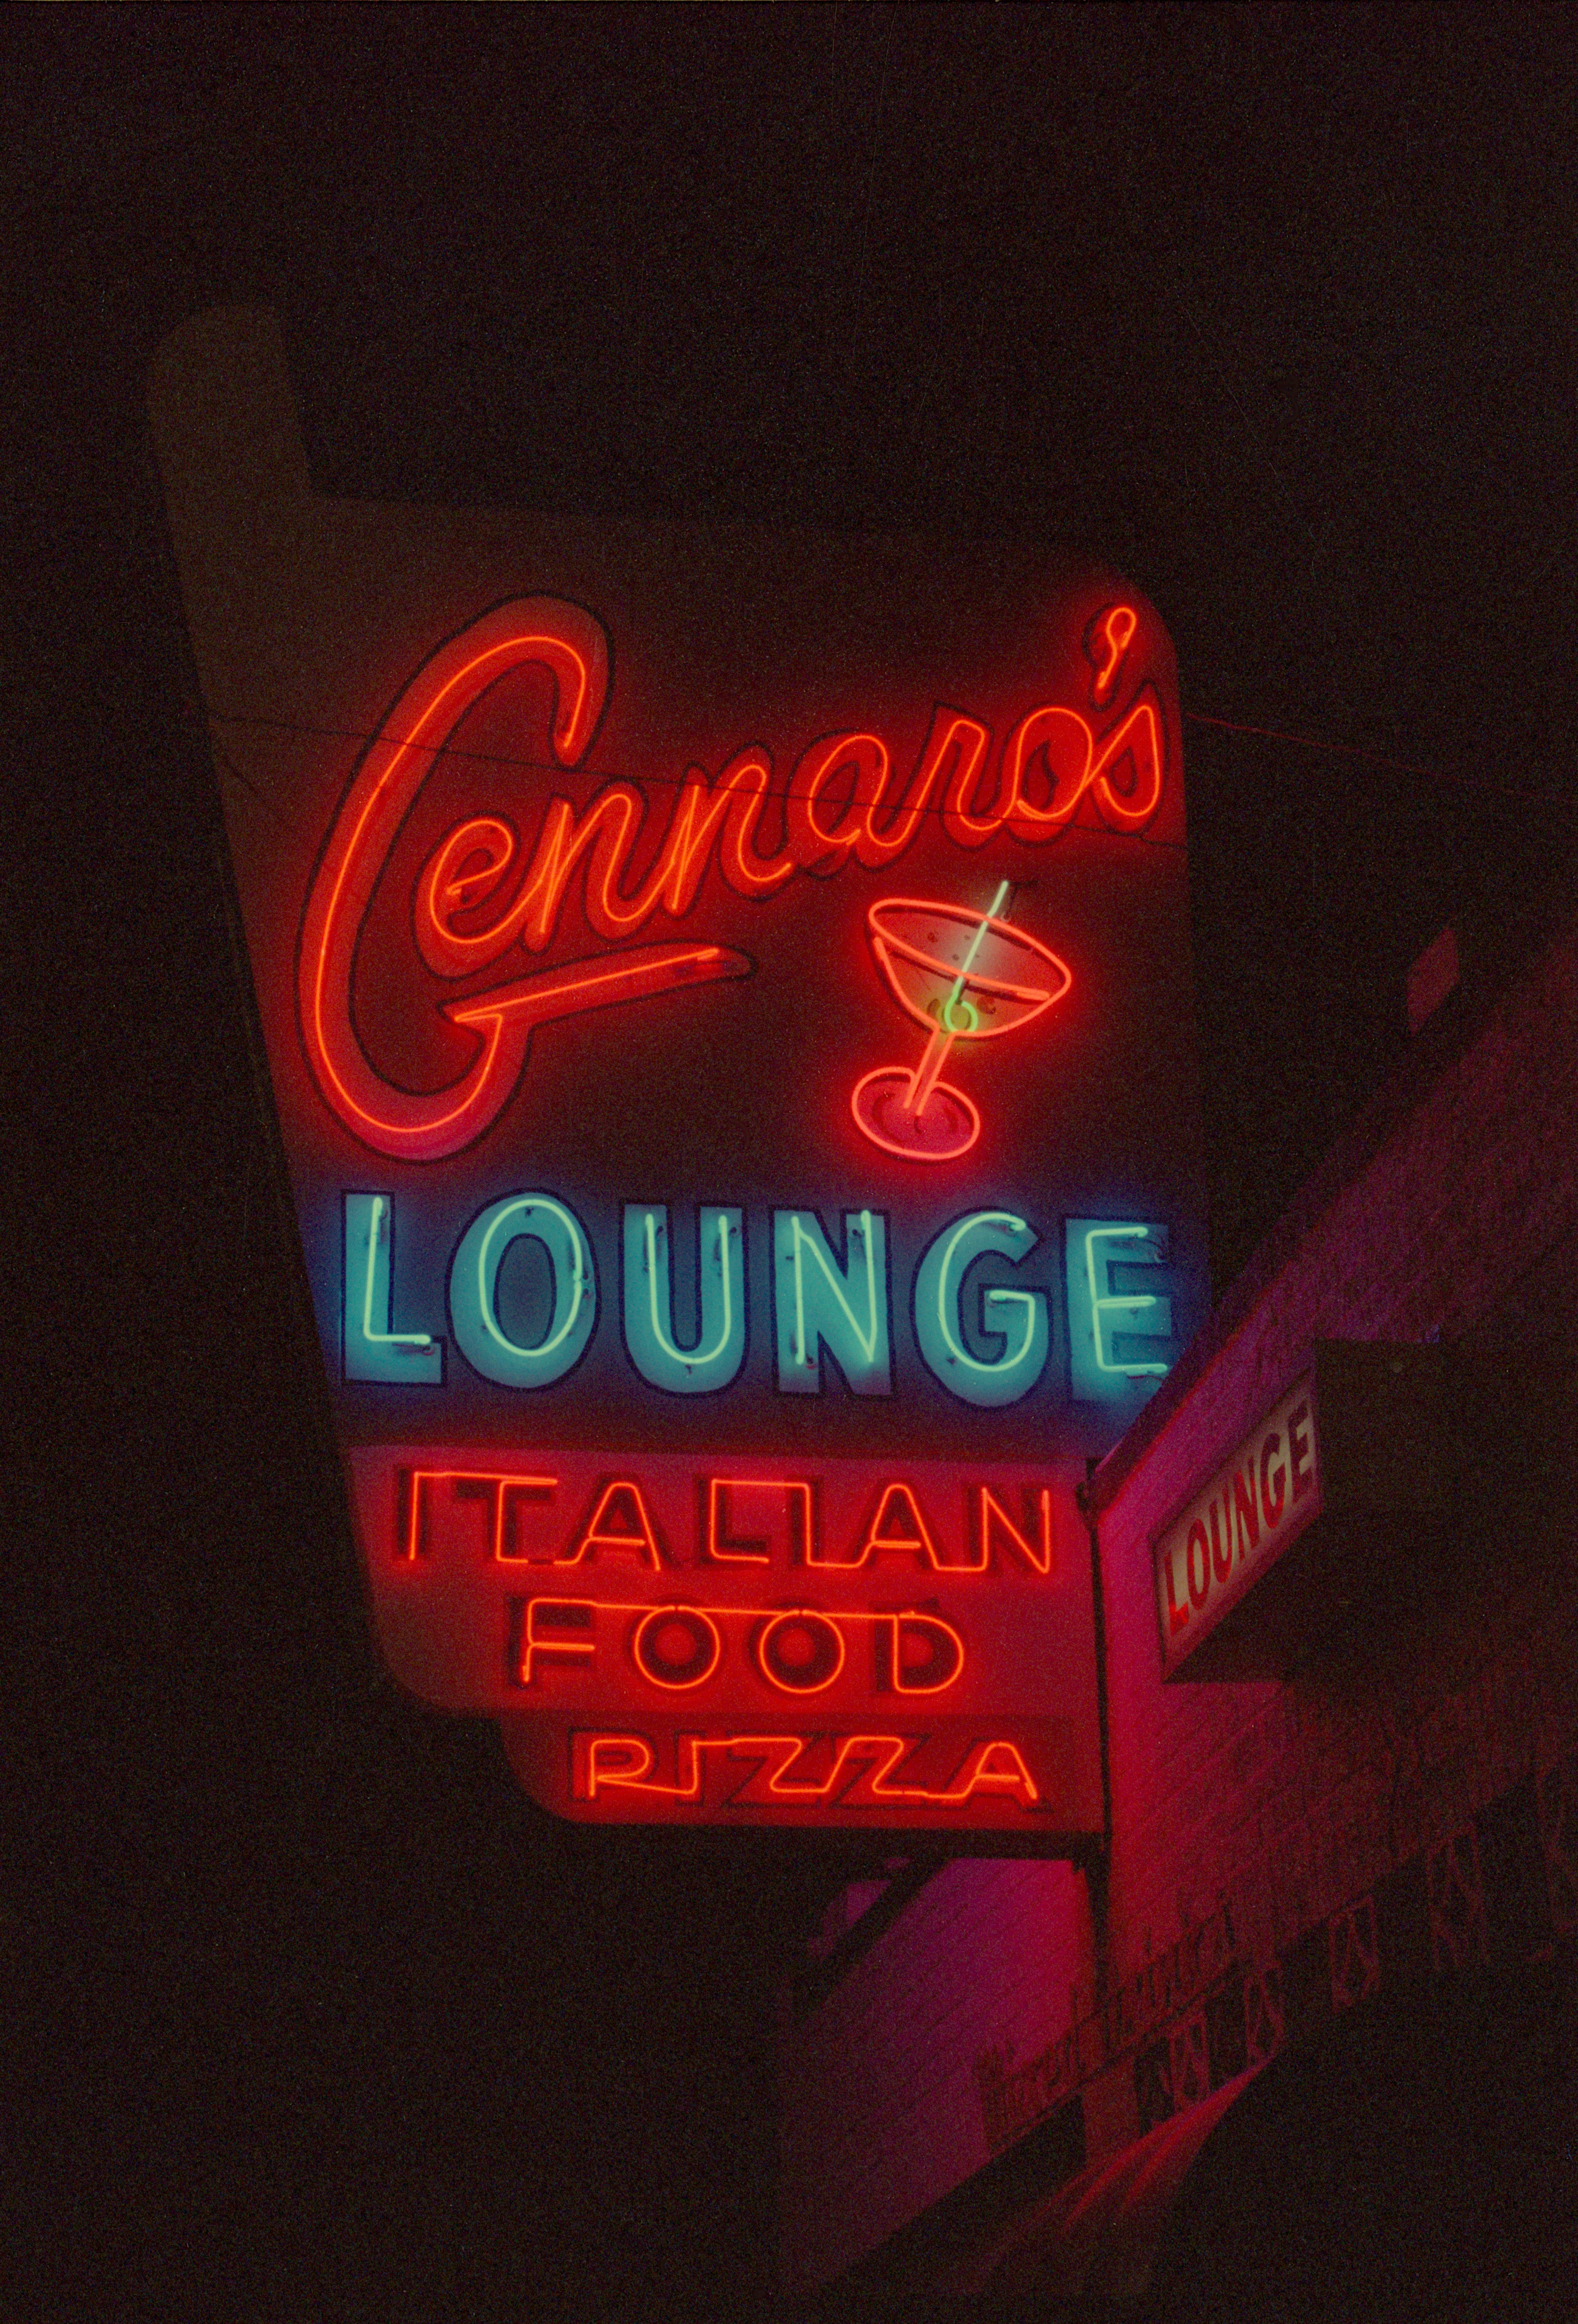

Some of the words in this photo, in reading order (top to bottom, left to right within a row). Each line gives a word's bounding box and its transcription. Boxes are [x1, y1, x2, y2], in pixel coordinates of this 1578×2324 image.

[343, 1189, 1173, 1405] LOUNGE
[400, 1465, 1053, 1573] ITALIAN
[1164, 1399, 1312, 1632] LOUNGE
[513, 1595, 965, 1694] FOOD
[572, 1728, 1048, 1808] PIZZA
